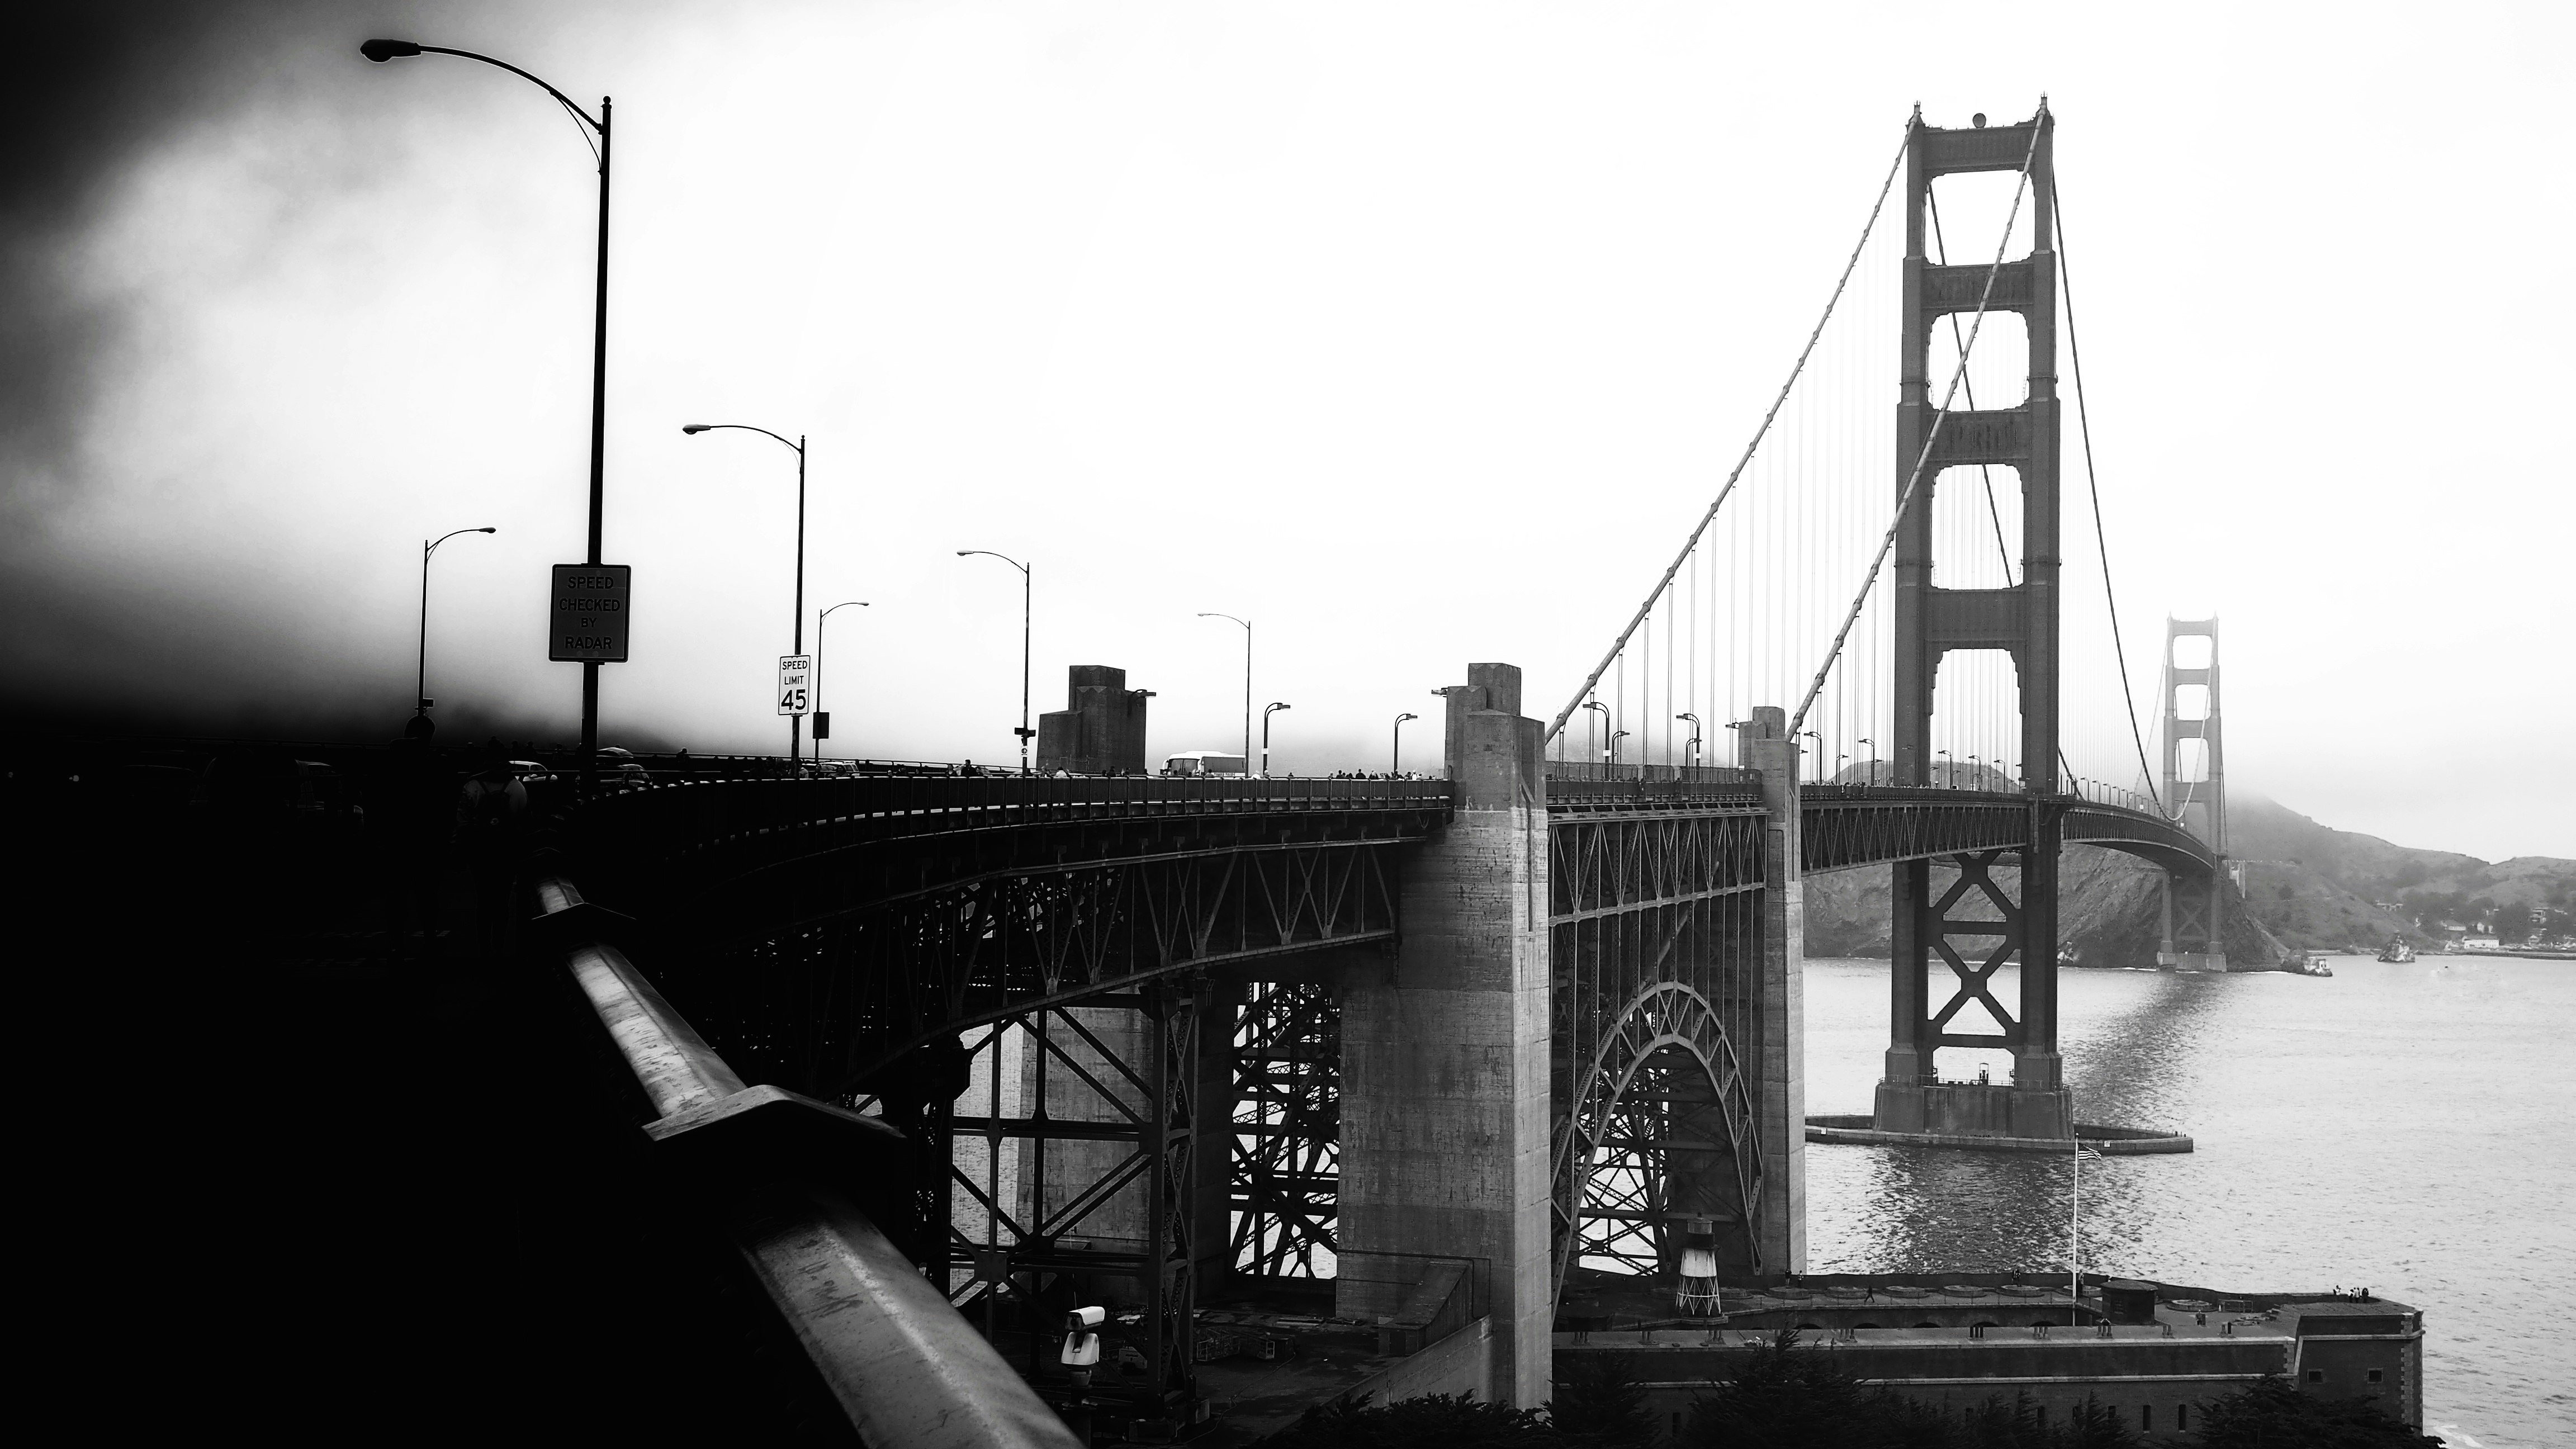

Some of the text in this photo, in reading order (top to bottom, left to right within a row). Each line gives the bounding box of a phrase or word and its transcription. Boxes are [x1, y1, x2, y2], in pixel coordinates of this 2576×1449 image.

[567, 576, 613, 589] SPEED
[559, 599, 620, 611] CHECKED
[581, 618, 597, 627] BY
[565, 637, 612, 649] RADAR
[783, 661, 807, 670] SPEED
[784, 676, 803, 685] LIMIT
[782, 689, 806, 710] 45
